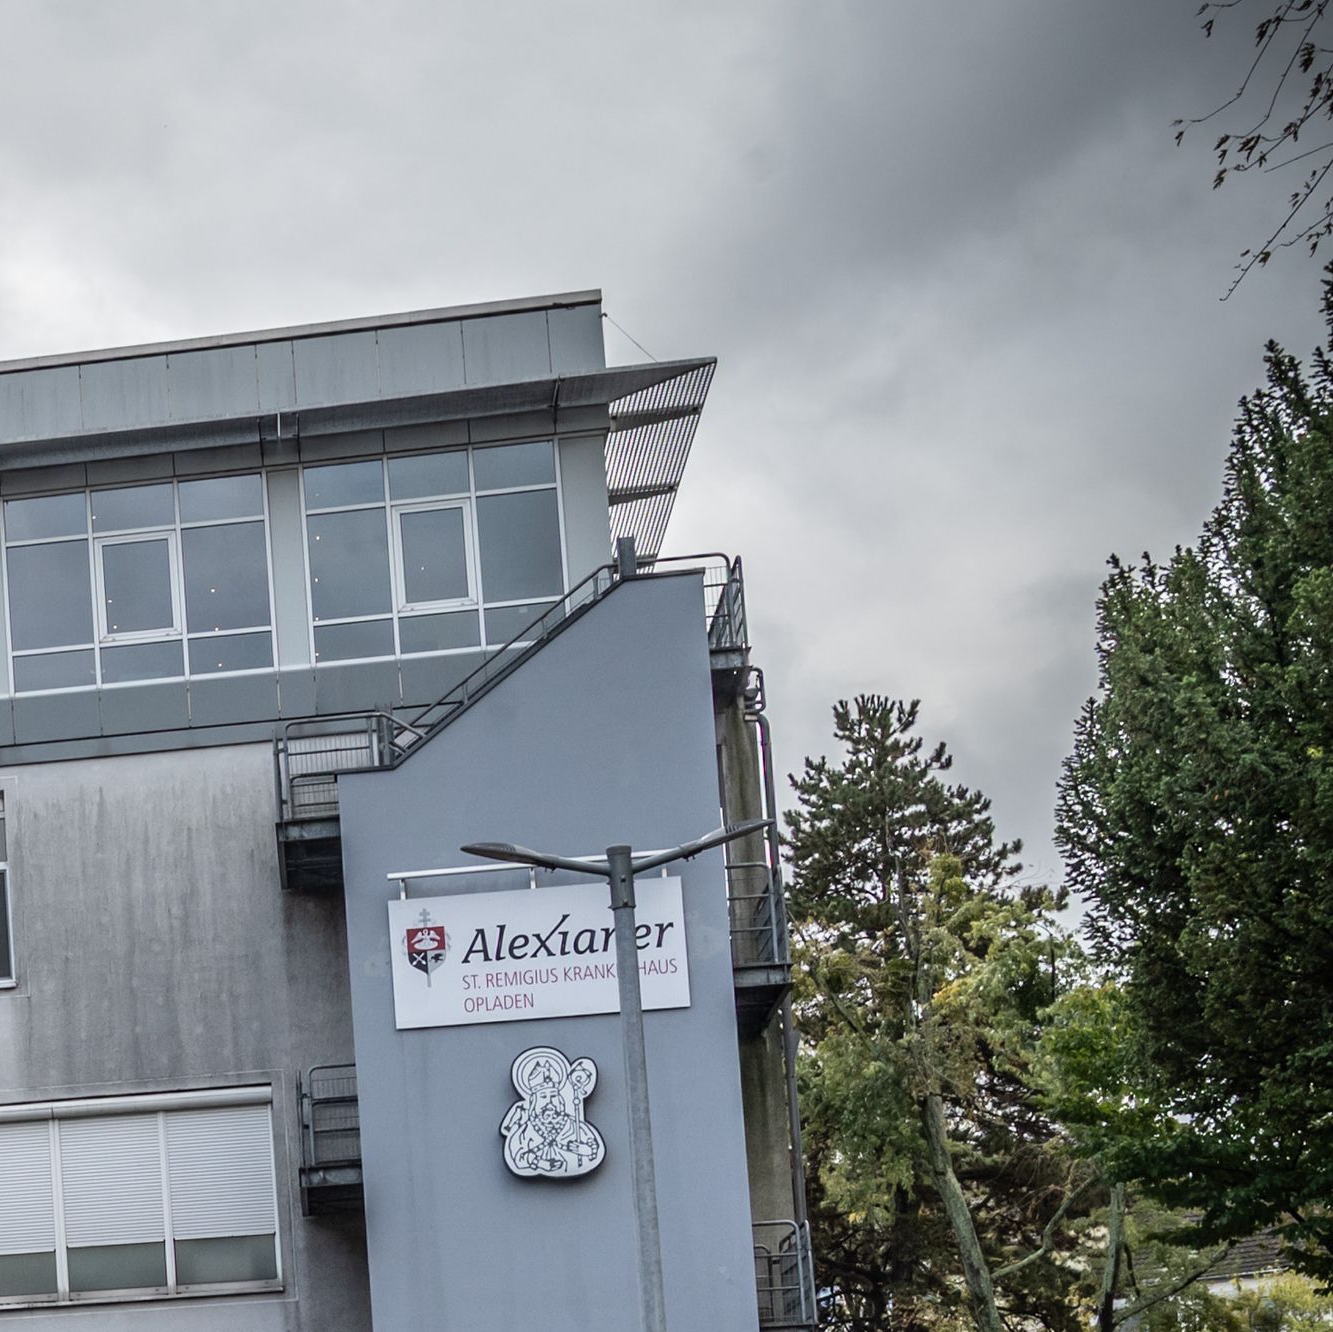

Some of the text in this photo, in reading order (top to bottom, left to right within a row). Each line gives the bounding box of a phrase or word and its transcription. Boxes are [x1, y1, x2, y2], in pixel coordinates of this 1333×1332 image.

[462, 957, 678, 990] ST. REMIGIUS KRANKHAUS
[464, 992, 534, 1013] OPLADEN
